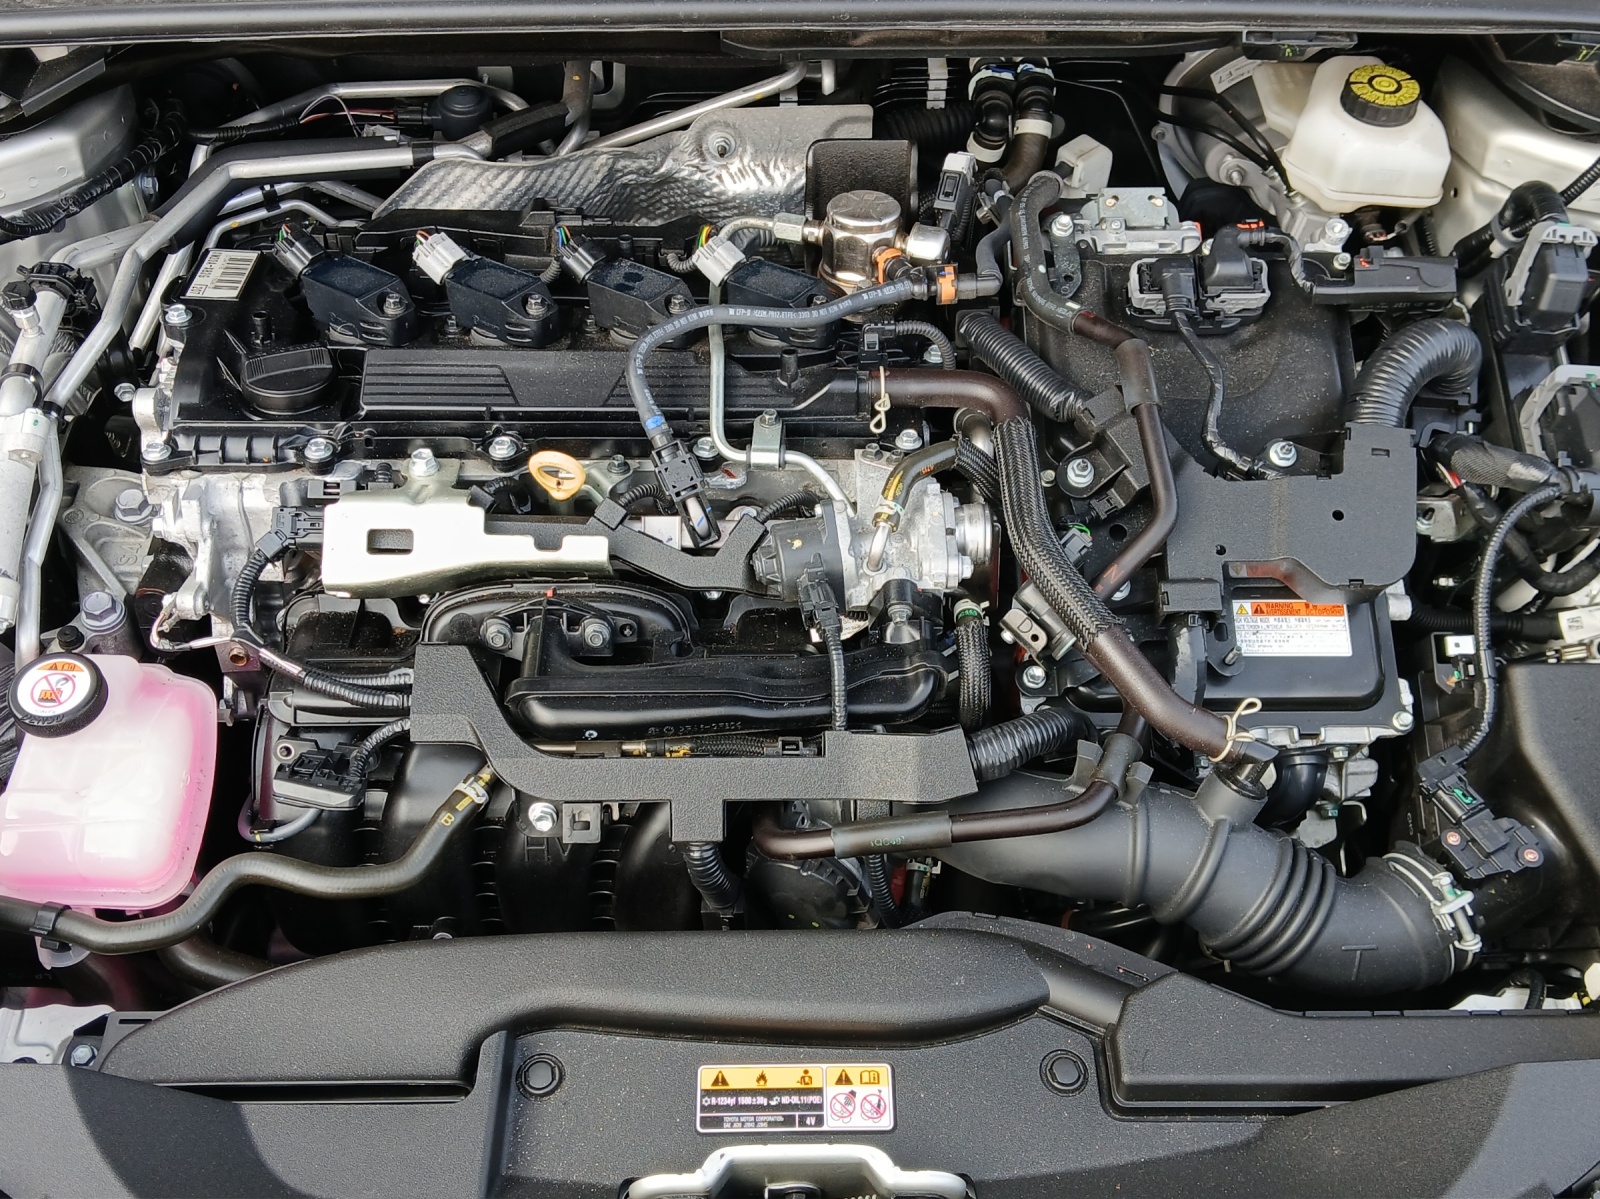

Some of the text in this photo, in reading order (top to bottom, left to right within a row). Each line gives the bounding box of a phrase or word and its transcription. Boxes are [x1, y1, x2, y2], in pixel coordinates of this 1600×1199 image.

[21, 713, 64, 725] DENSO
[1341, 944, 1377, 980] T
[711, 1096, 736, 1107] R-1234yf
[805, 1116, 816, 1126] 4V
